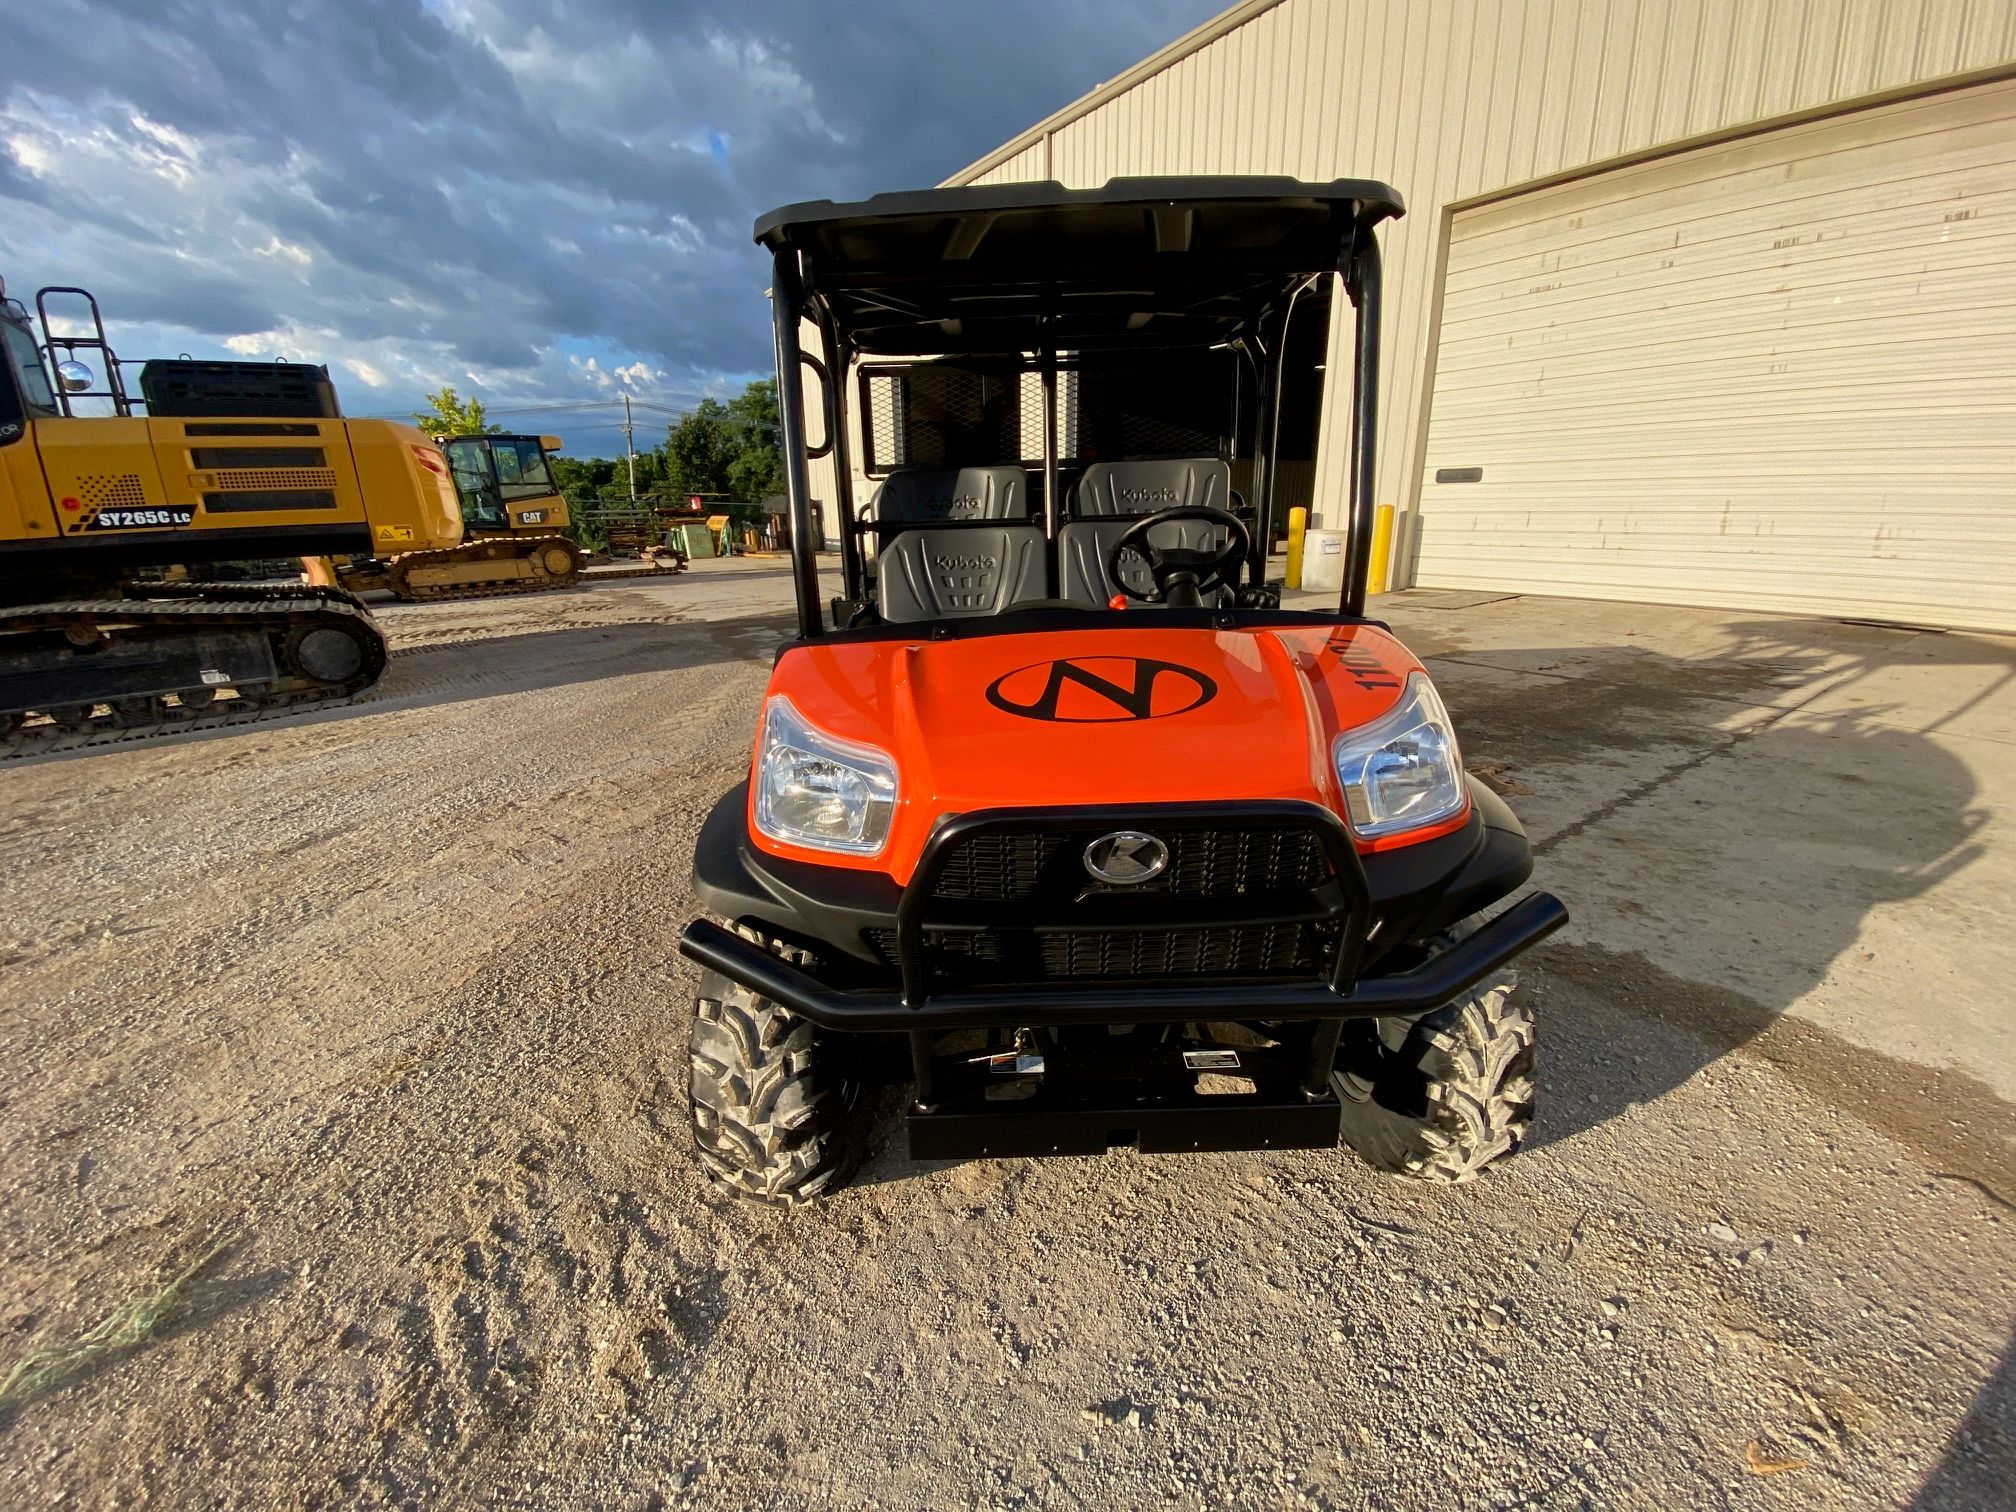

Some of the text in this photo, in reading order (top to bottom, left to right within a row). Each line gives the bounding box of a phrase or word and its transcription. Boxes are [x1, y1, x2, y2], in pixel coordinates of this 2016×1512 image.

[1122, 488, 1179, 502] Kubota
[99, 511, 191, 526] SY265C LC
[523, 512, 541, 523] CAT
[936, 556, 997, 570] Kubota
[985, 656, 1219, 723] N
